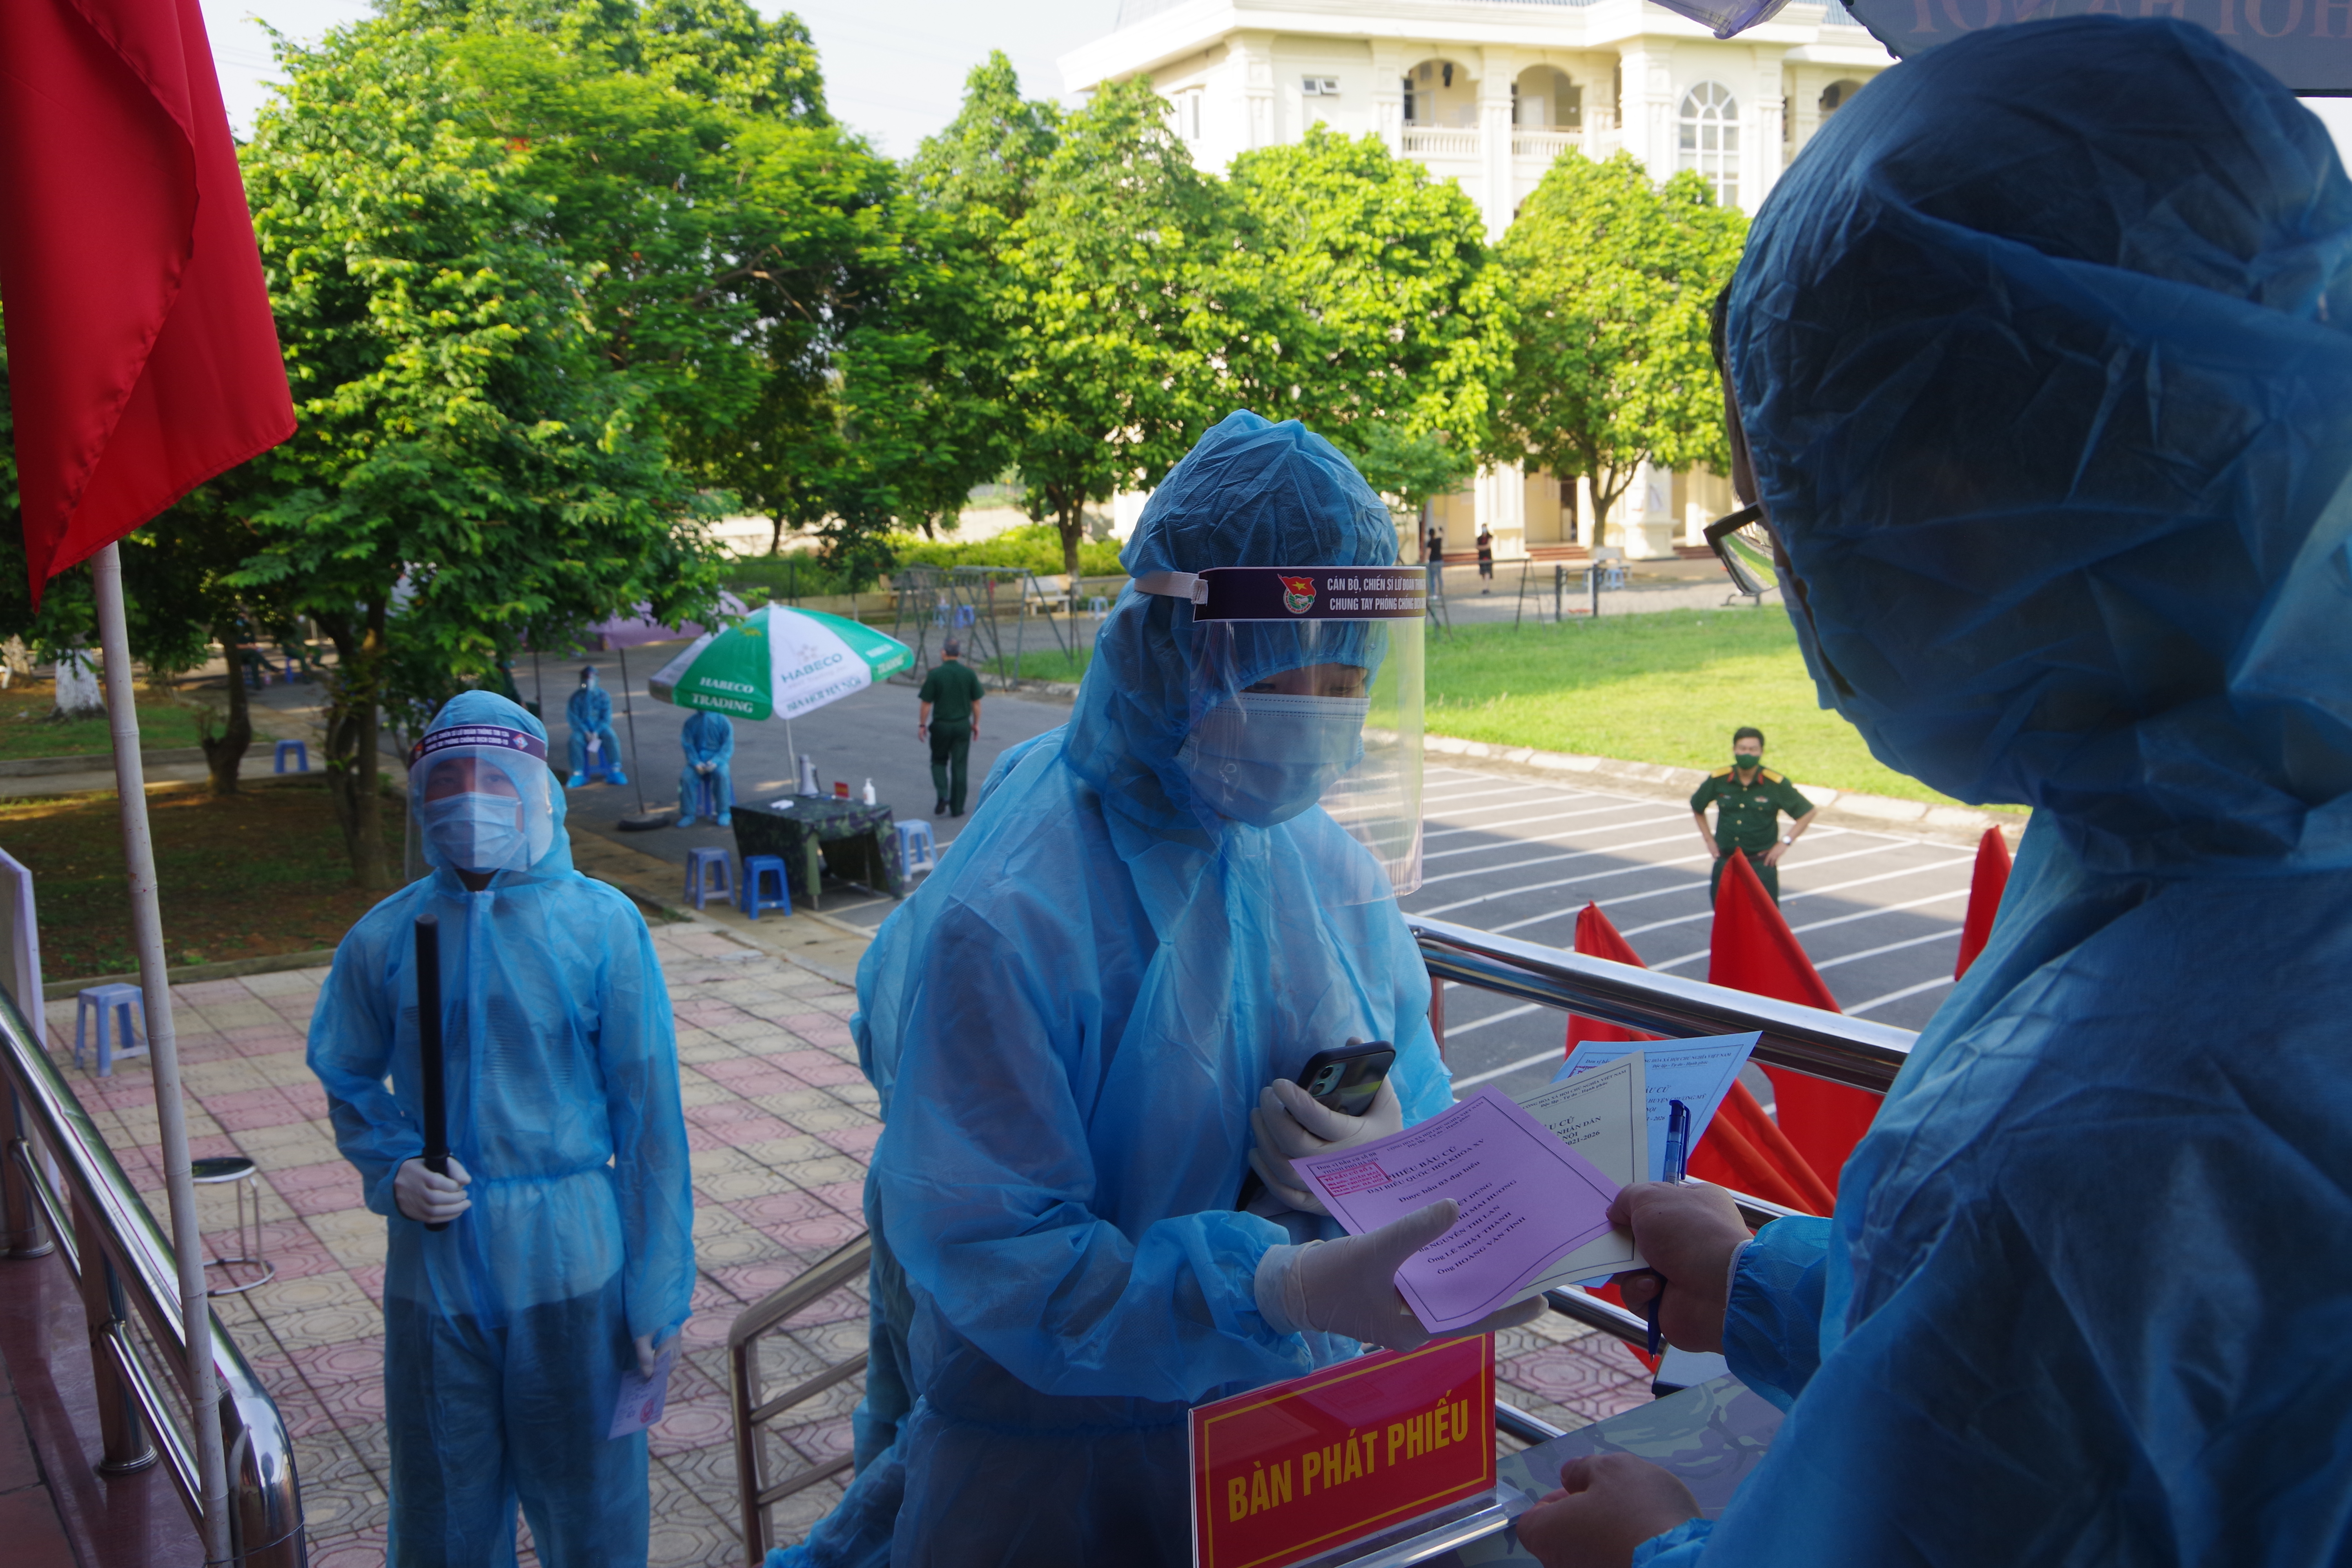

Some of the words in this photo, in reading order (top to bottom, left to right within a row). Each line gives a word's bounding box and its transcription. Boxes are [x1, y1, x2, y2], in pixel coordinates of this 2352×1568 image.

[1327, 575, 1345, 591] CÁN
[1348, 575, 1361, 593] BỘ,
[1363, 574, 1386, 591] CHIẾN
[1387, 576, 1394, 591] SĨ
[1329, 598, 1359, 610] CHUNG
[1361, 598, 1374, 610] TAY
[1375, 595, 1397, 610] PHÒNG
[1398, 593, 1414, 610] CHỐNG
[781, 653, 842, 682] HABECO
[700, 677, 754, 693] HABECO
[691, 693, 753, 713] TRADING
[1557, 1125, 1581, 1136] NHÂN
[1583, 1116, 1601, 1127] DÂN
[1559, 1116, 1575, 1127] CỬ
[1562, 1132, 1577, 1141] NỘI
[1386, 1165, 1417, 1180] PHIẾU
[1442, 1146, 1456, 1156] CỬ
[1469, 1200, 1486, 1213] MAI
[1486, 1181, 1517, 1201] HƯƠNG
[1430, 1228, 1466, 1249] NGUYỄN
[1466, 1218, 1483, 1229] THỊ
[1483, 1205, 1500, 1219] LAN
[1445, 1249, 1458, 1257] LÊ
[1458, 1233, 1481, 1250] NHẬT
[1482, 1212, 1512, 1233] THÀNH
[1455, 1246, 1486, 1267] HOÀNG
[1486, 1232, 1504, 1245] VĂN
[1228, 1460, 1292, 1523] BÀN
[1302, 1428, 1378, 1496] PHÁT
[1387, 1390, 1468, 1467] PHIẾU
